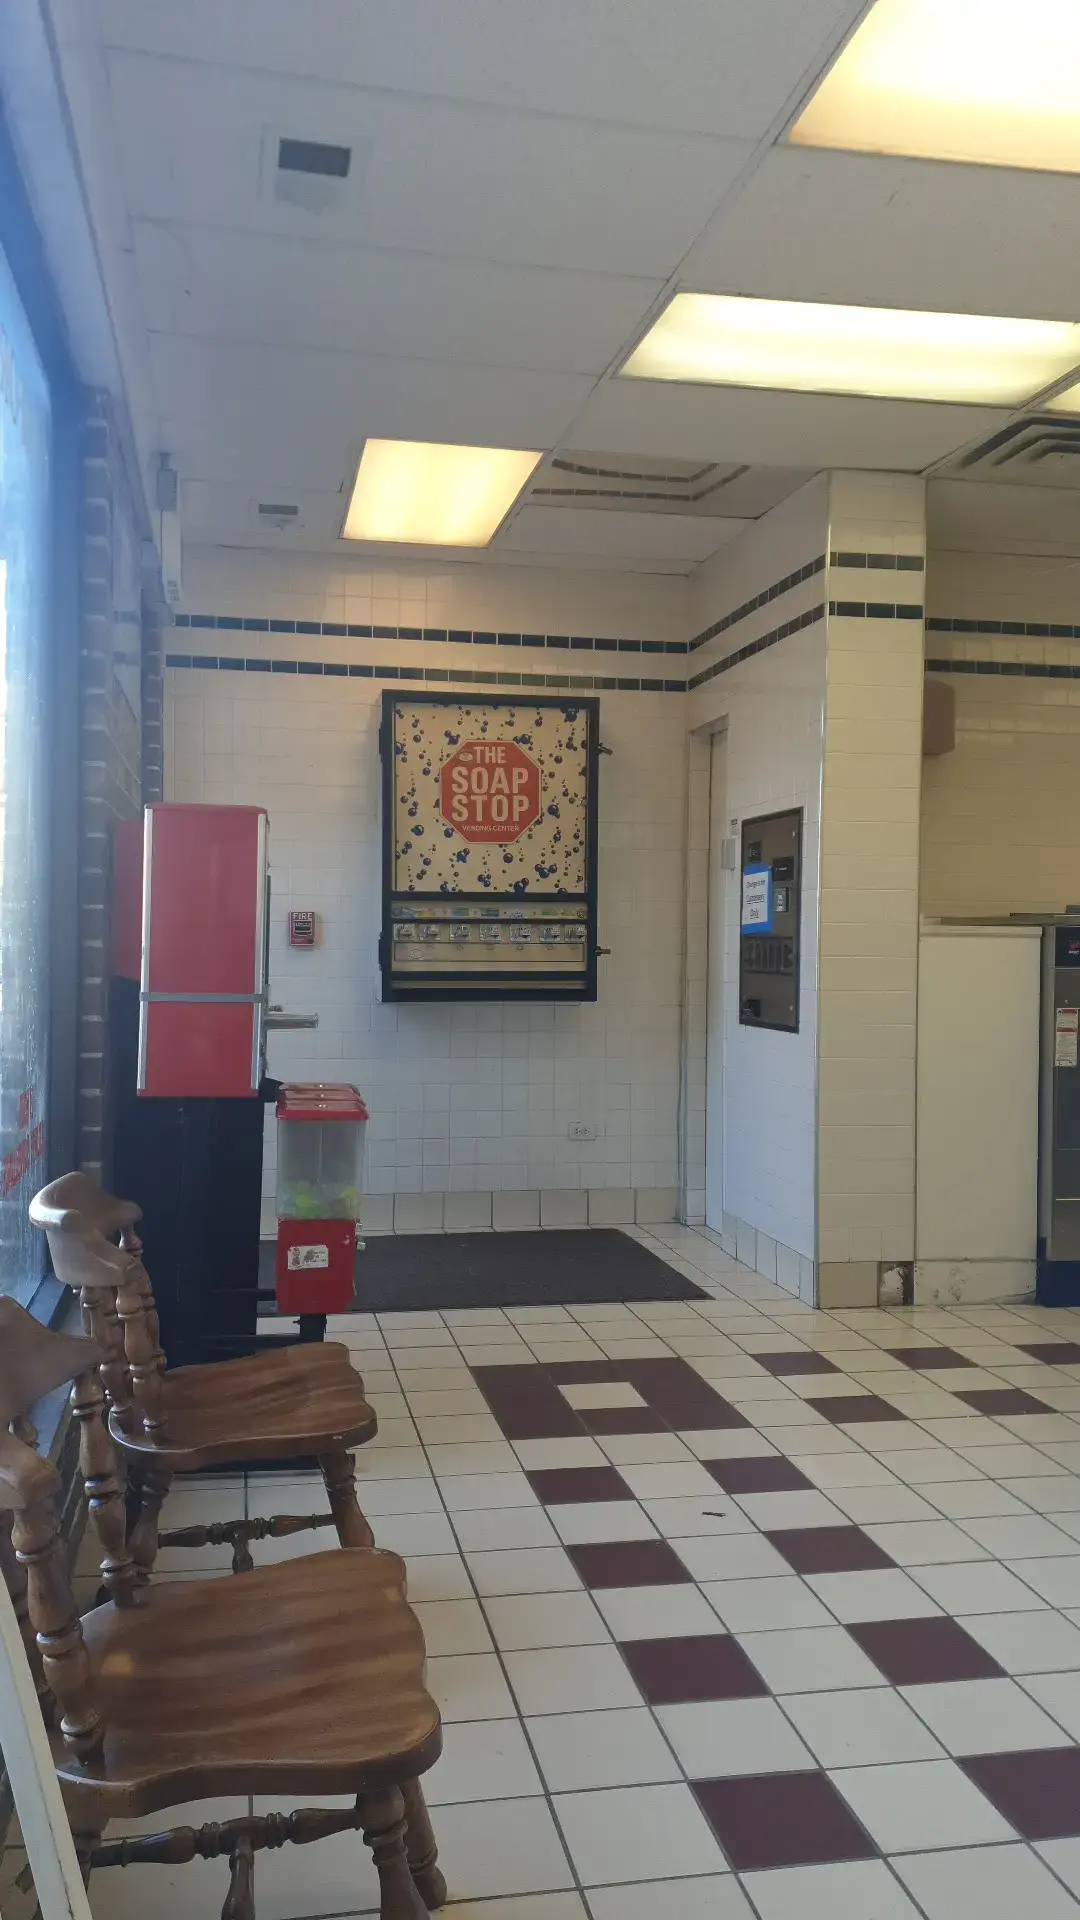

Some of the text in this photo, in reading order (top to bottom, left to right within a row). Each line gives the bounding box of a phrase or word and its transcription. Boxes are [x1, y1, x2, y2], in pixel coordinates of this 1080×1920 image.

[474, 746, 507, 764] THE
[451, 766, 529, 794] SOAP
[451, 794, 530, 822] STOP
[293, 912, 313, 920] FIRE
